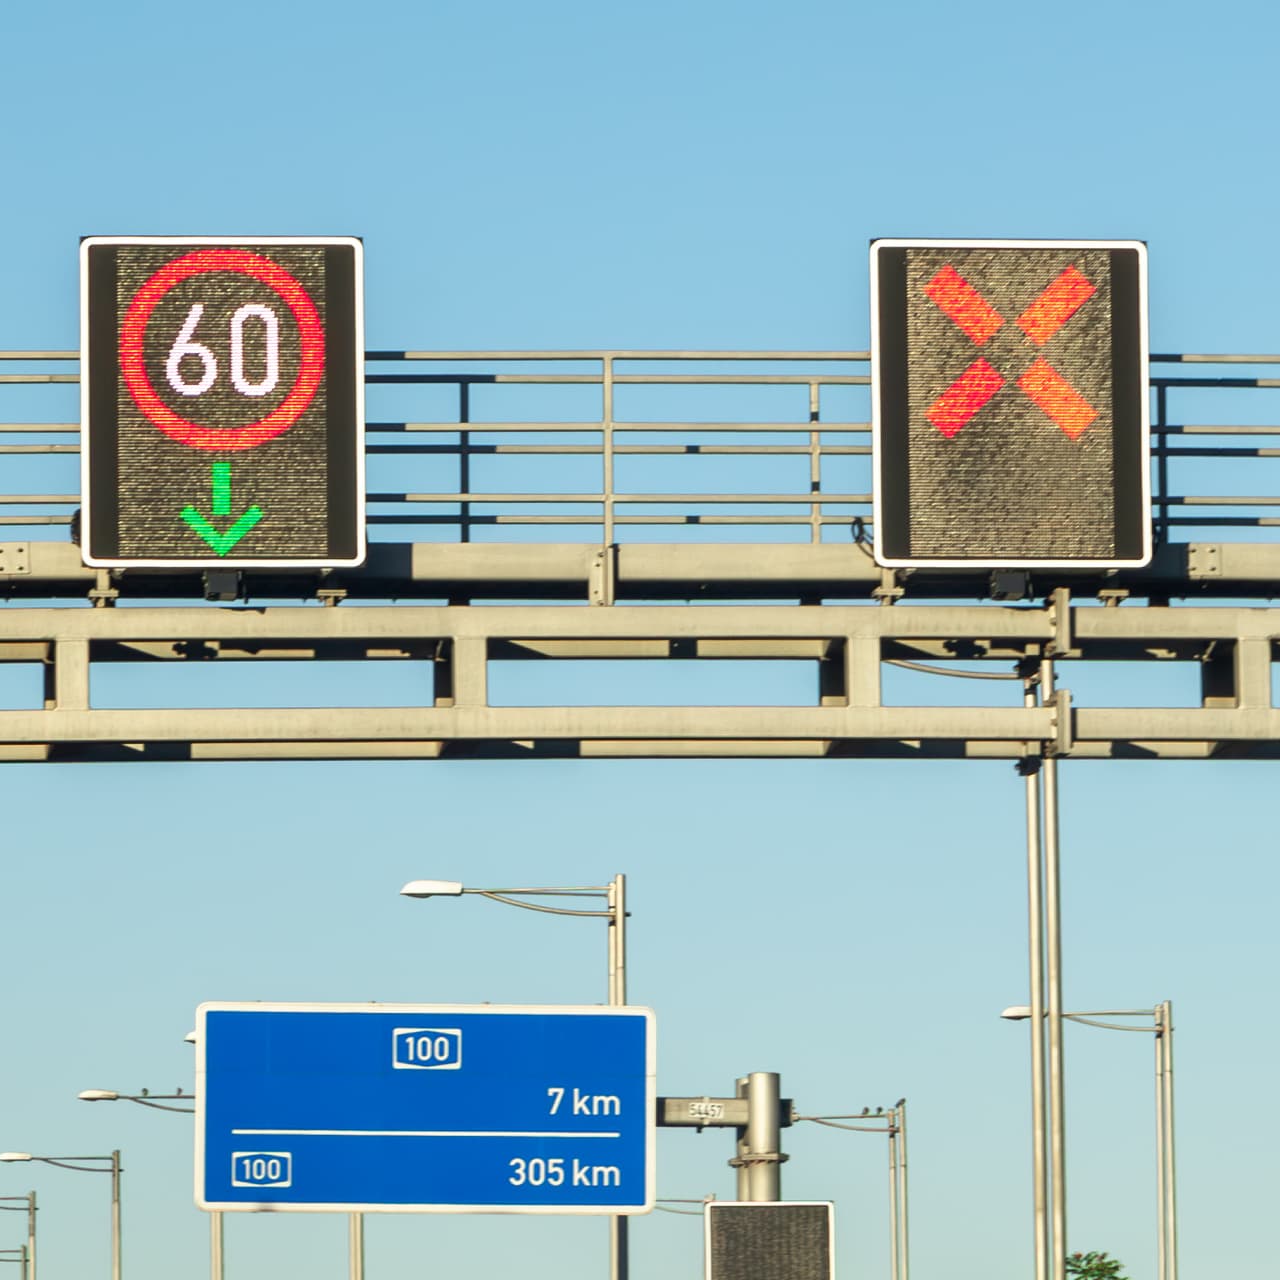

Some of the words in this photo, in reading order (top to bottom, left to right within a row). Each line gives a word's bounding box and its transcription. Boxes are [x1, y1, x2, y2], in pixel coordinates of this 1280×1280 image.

[165, 304, 280, 396] 60
[405, 1036, 449, 1061] 100
[547, 1087, 565, 1115] 7
[573, 1087, 621, 1115] km
[243, 1159, 281, 1180] 100
[509, 1158, 565, 1186] 305
[573, 1158, 620, 1186] km
